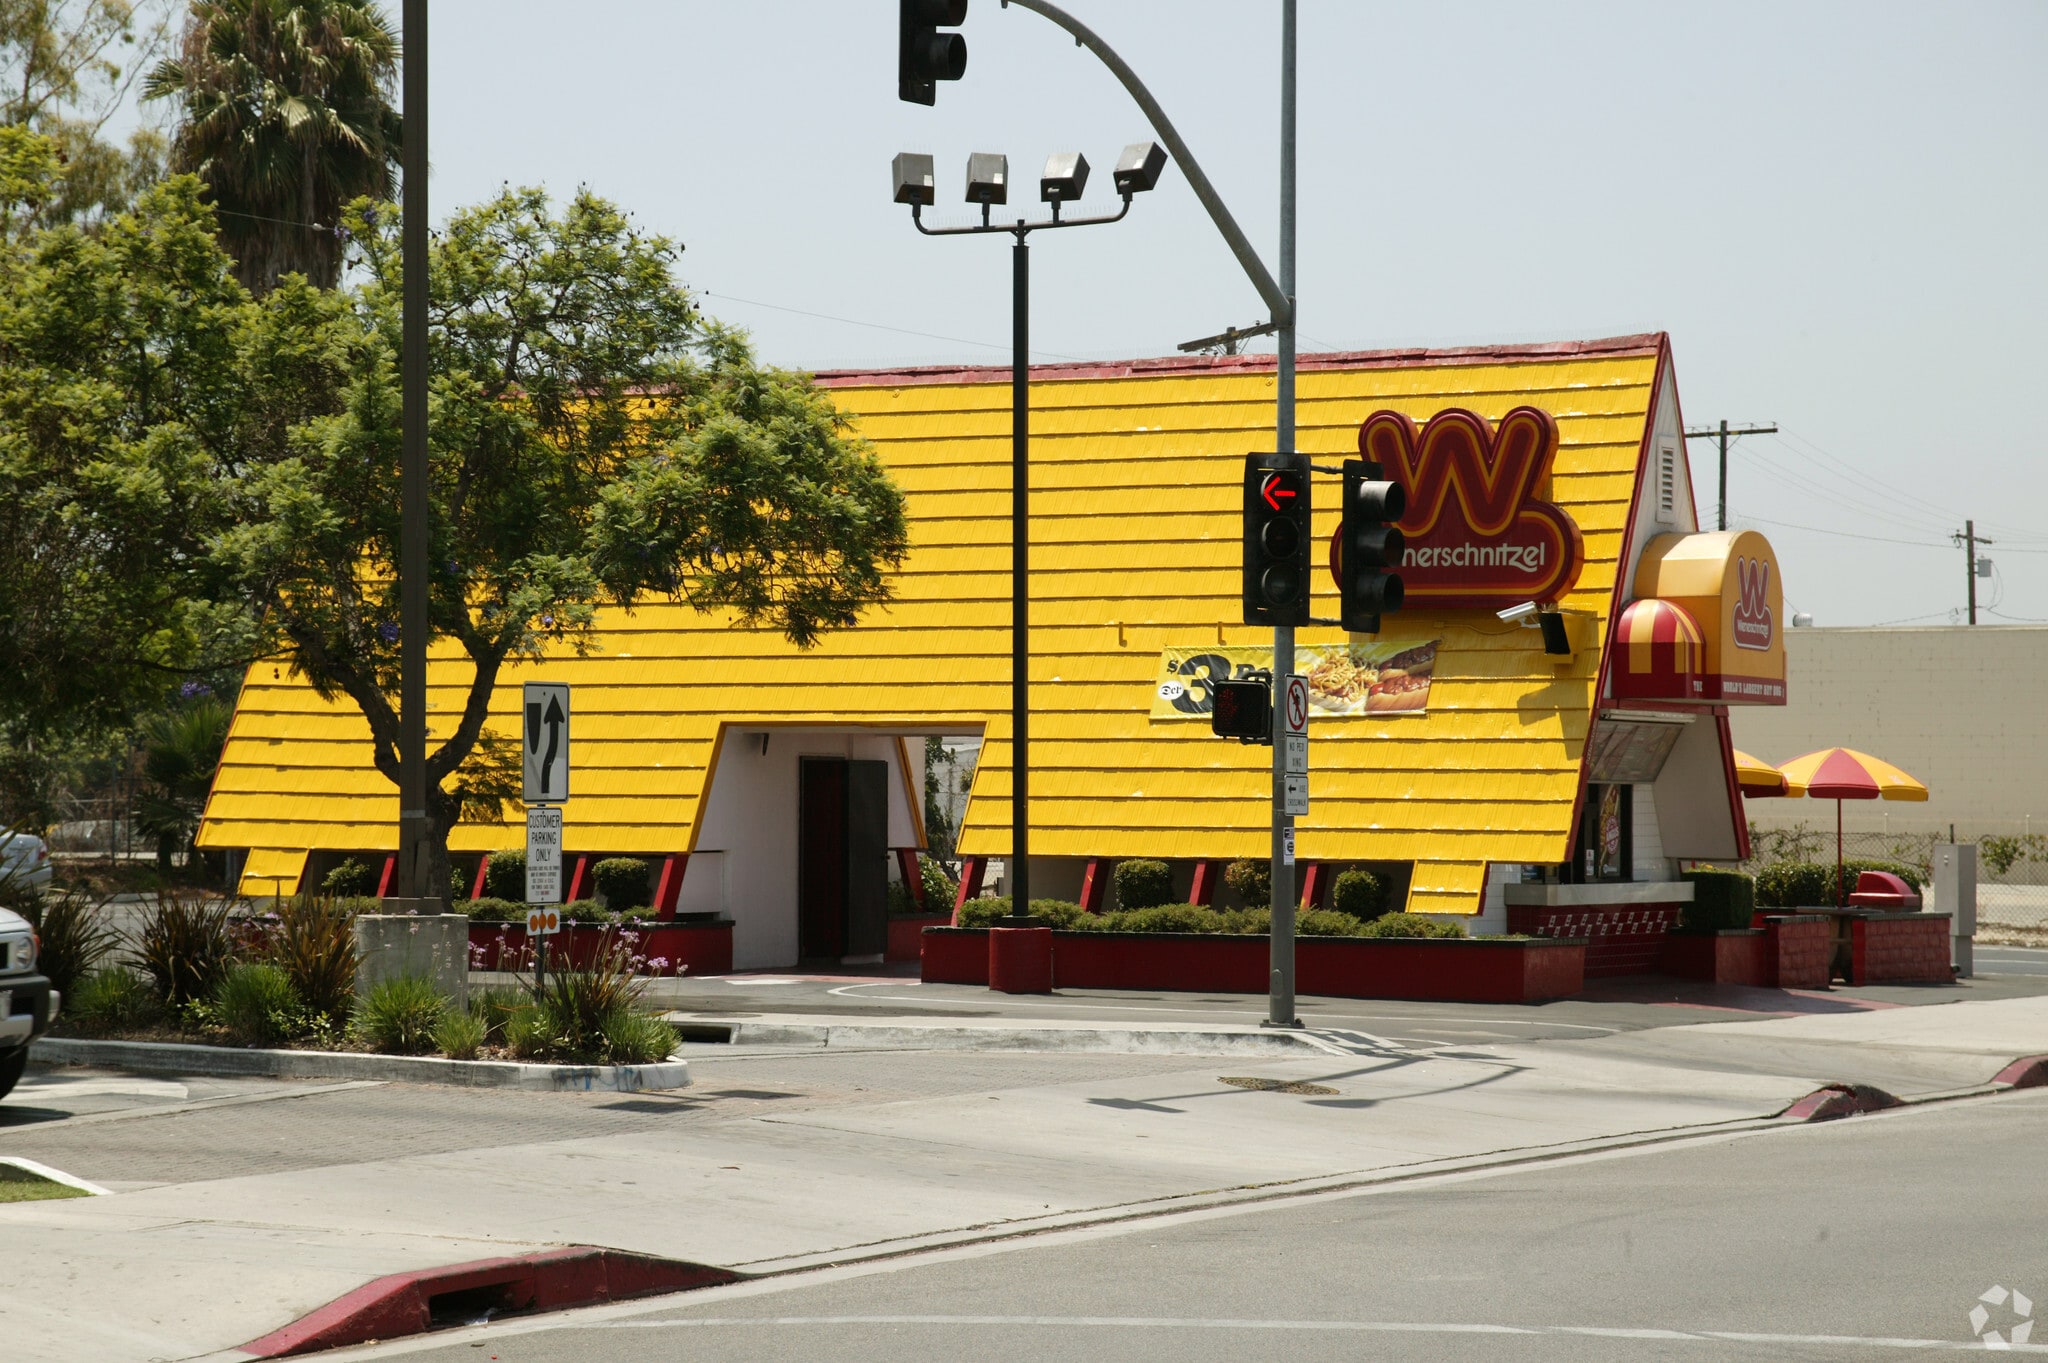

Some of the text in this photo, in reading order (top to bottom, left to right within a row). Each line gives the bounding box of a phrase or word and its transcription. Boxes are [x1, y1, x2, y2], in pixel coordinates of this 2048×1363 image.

[1367, 418, 1540, 537] W
[1402, 542, 1546, 573] nerschnitzel
[1737, 556, 1769, 619] W
[1161, 685, 1182, 696] Der
[529, 815, 560, 828] CUSTOMER
[531, 831, 557, 845] PARKING
[535, 847, 552, 861] ONLY
